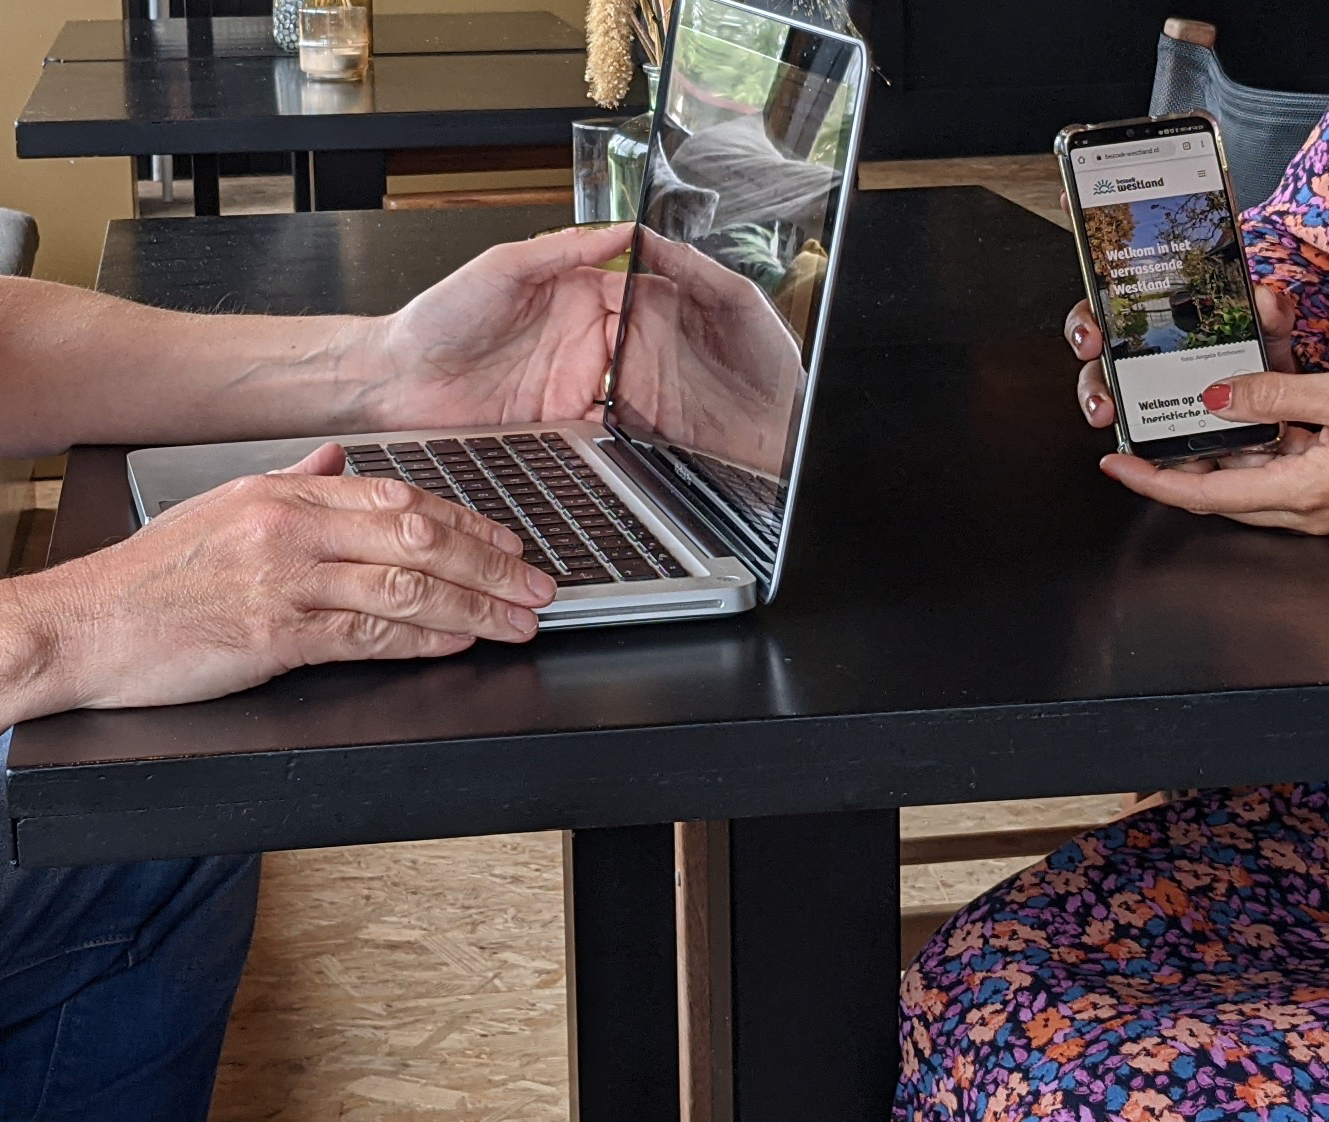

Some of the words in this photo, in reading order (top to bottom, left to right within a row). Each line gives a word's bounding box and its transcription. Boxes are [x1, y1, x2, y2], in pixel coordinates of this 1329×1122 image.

[1117, 178, 1164, 192] westland
[1106, 247, 1155, 261] Welkom
[1157, 243, 1169, 254] in
[1170, 239, 1191, 253] het
[1110, 258, 1184, 278] verrassende
[1113, 276, 1171, 296] Westland
[1138, 398, 1179, 411] Welkom
[1182, 396, 1195, 408] op
